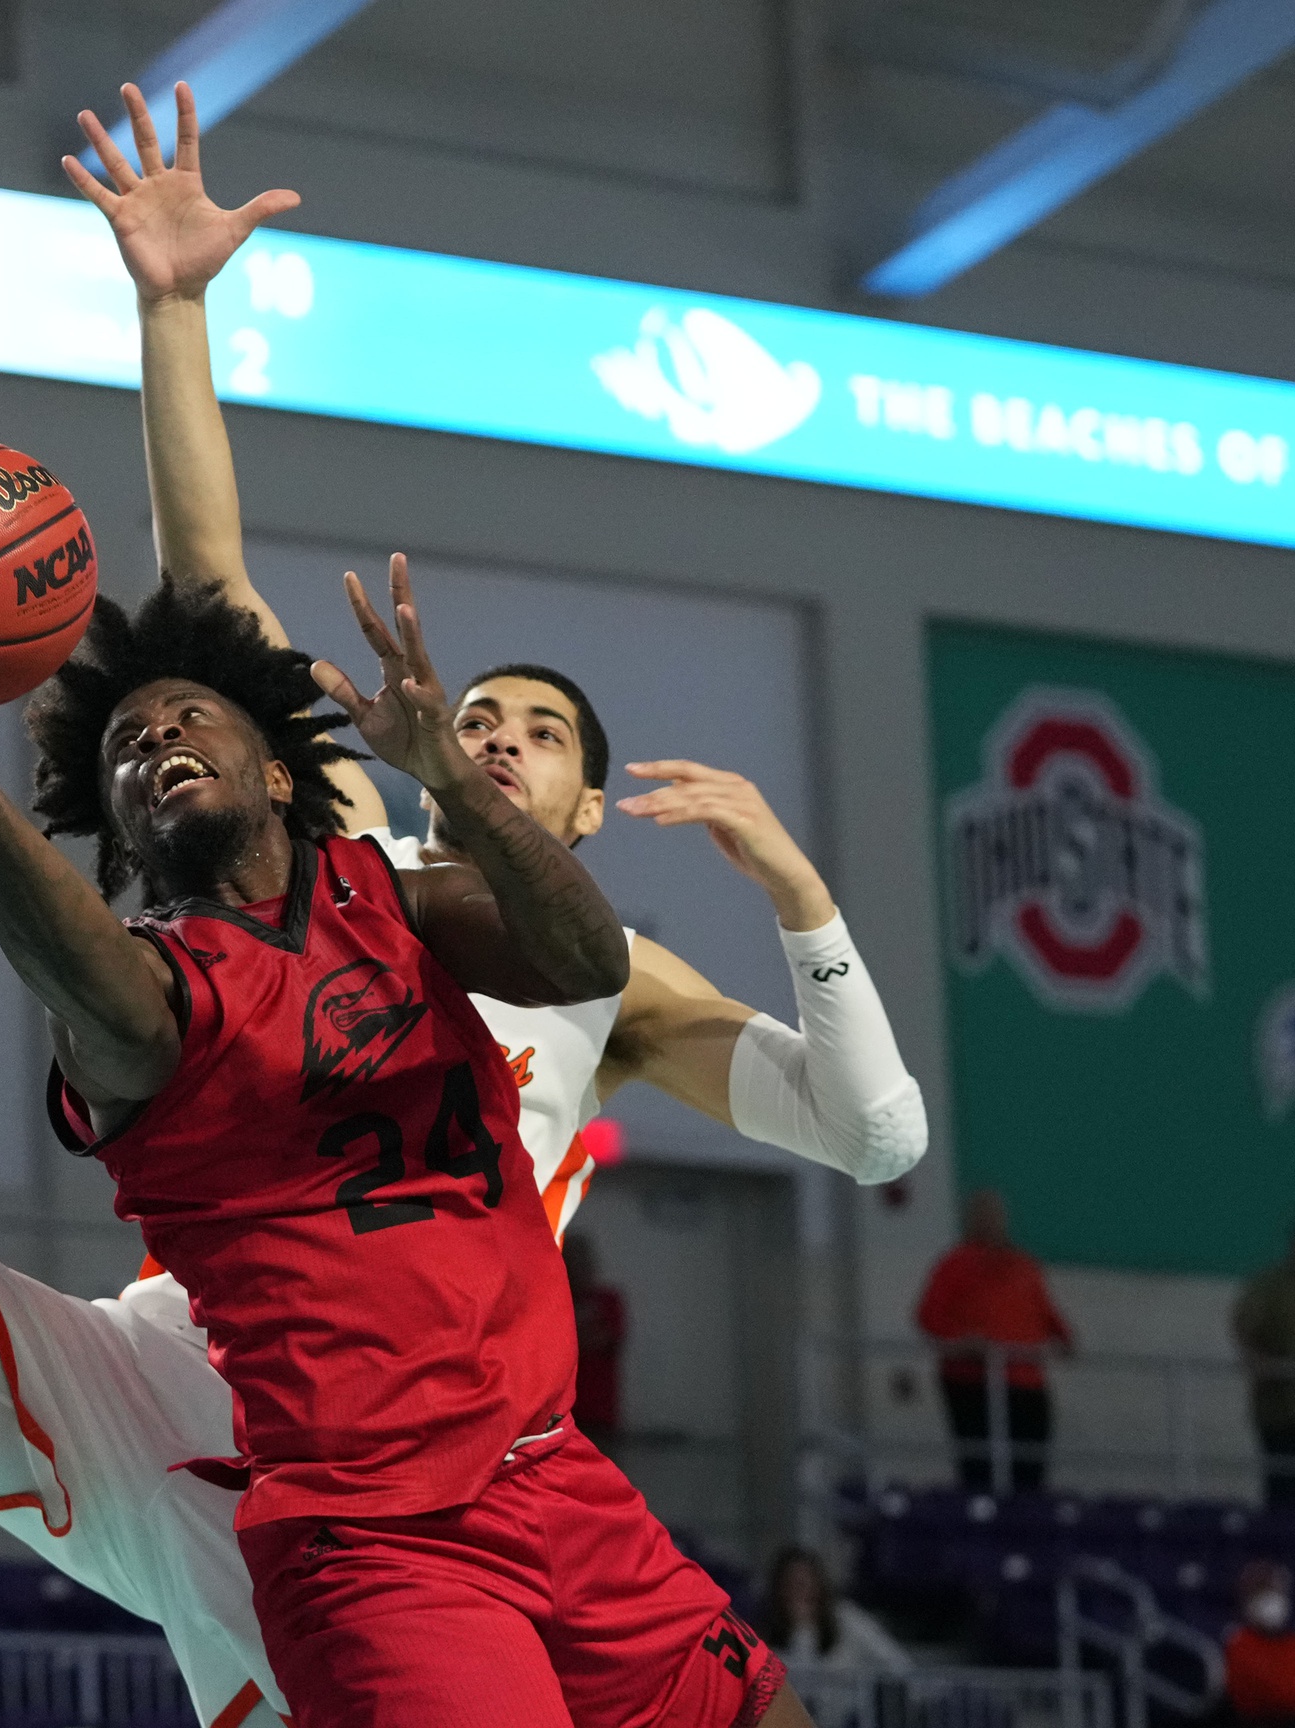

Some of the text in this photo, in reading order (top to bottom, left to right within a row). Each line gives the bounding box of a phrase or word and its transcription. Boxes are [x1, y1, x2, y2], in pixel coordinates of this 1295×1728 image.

[229, 327, 272, 395] 2
[848, 374, 1289, 486] THE BEACHES OF
[13, 526, 95, 605] NCAA
[317, 1061, 504, 1236] 24
